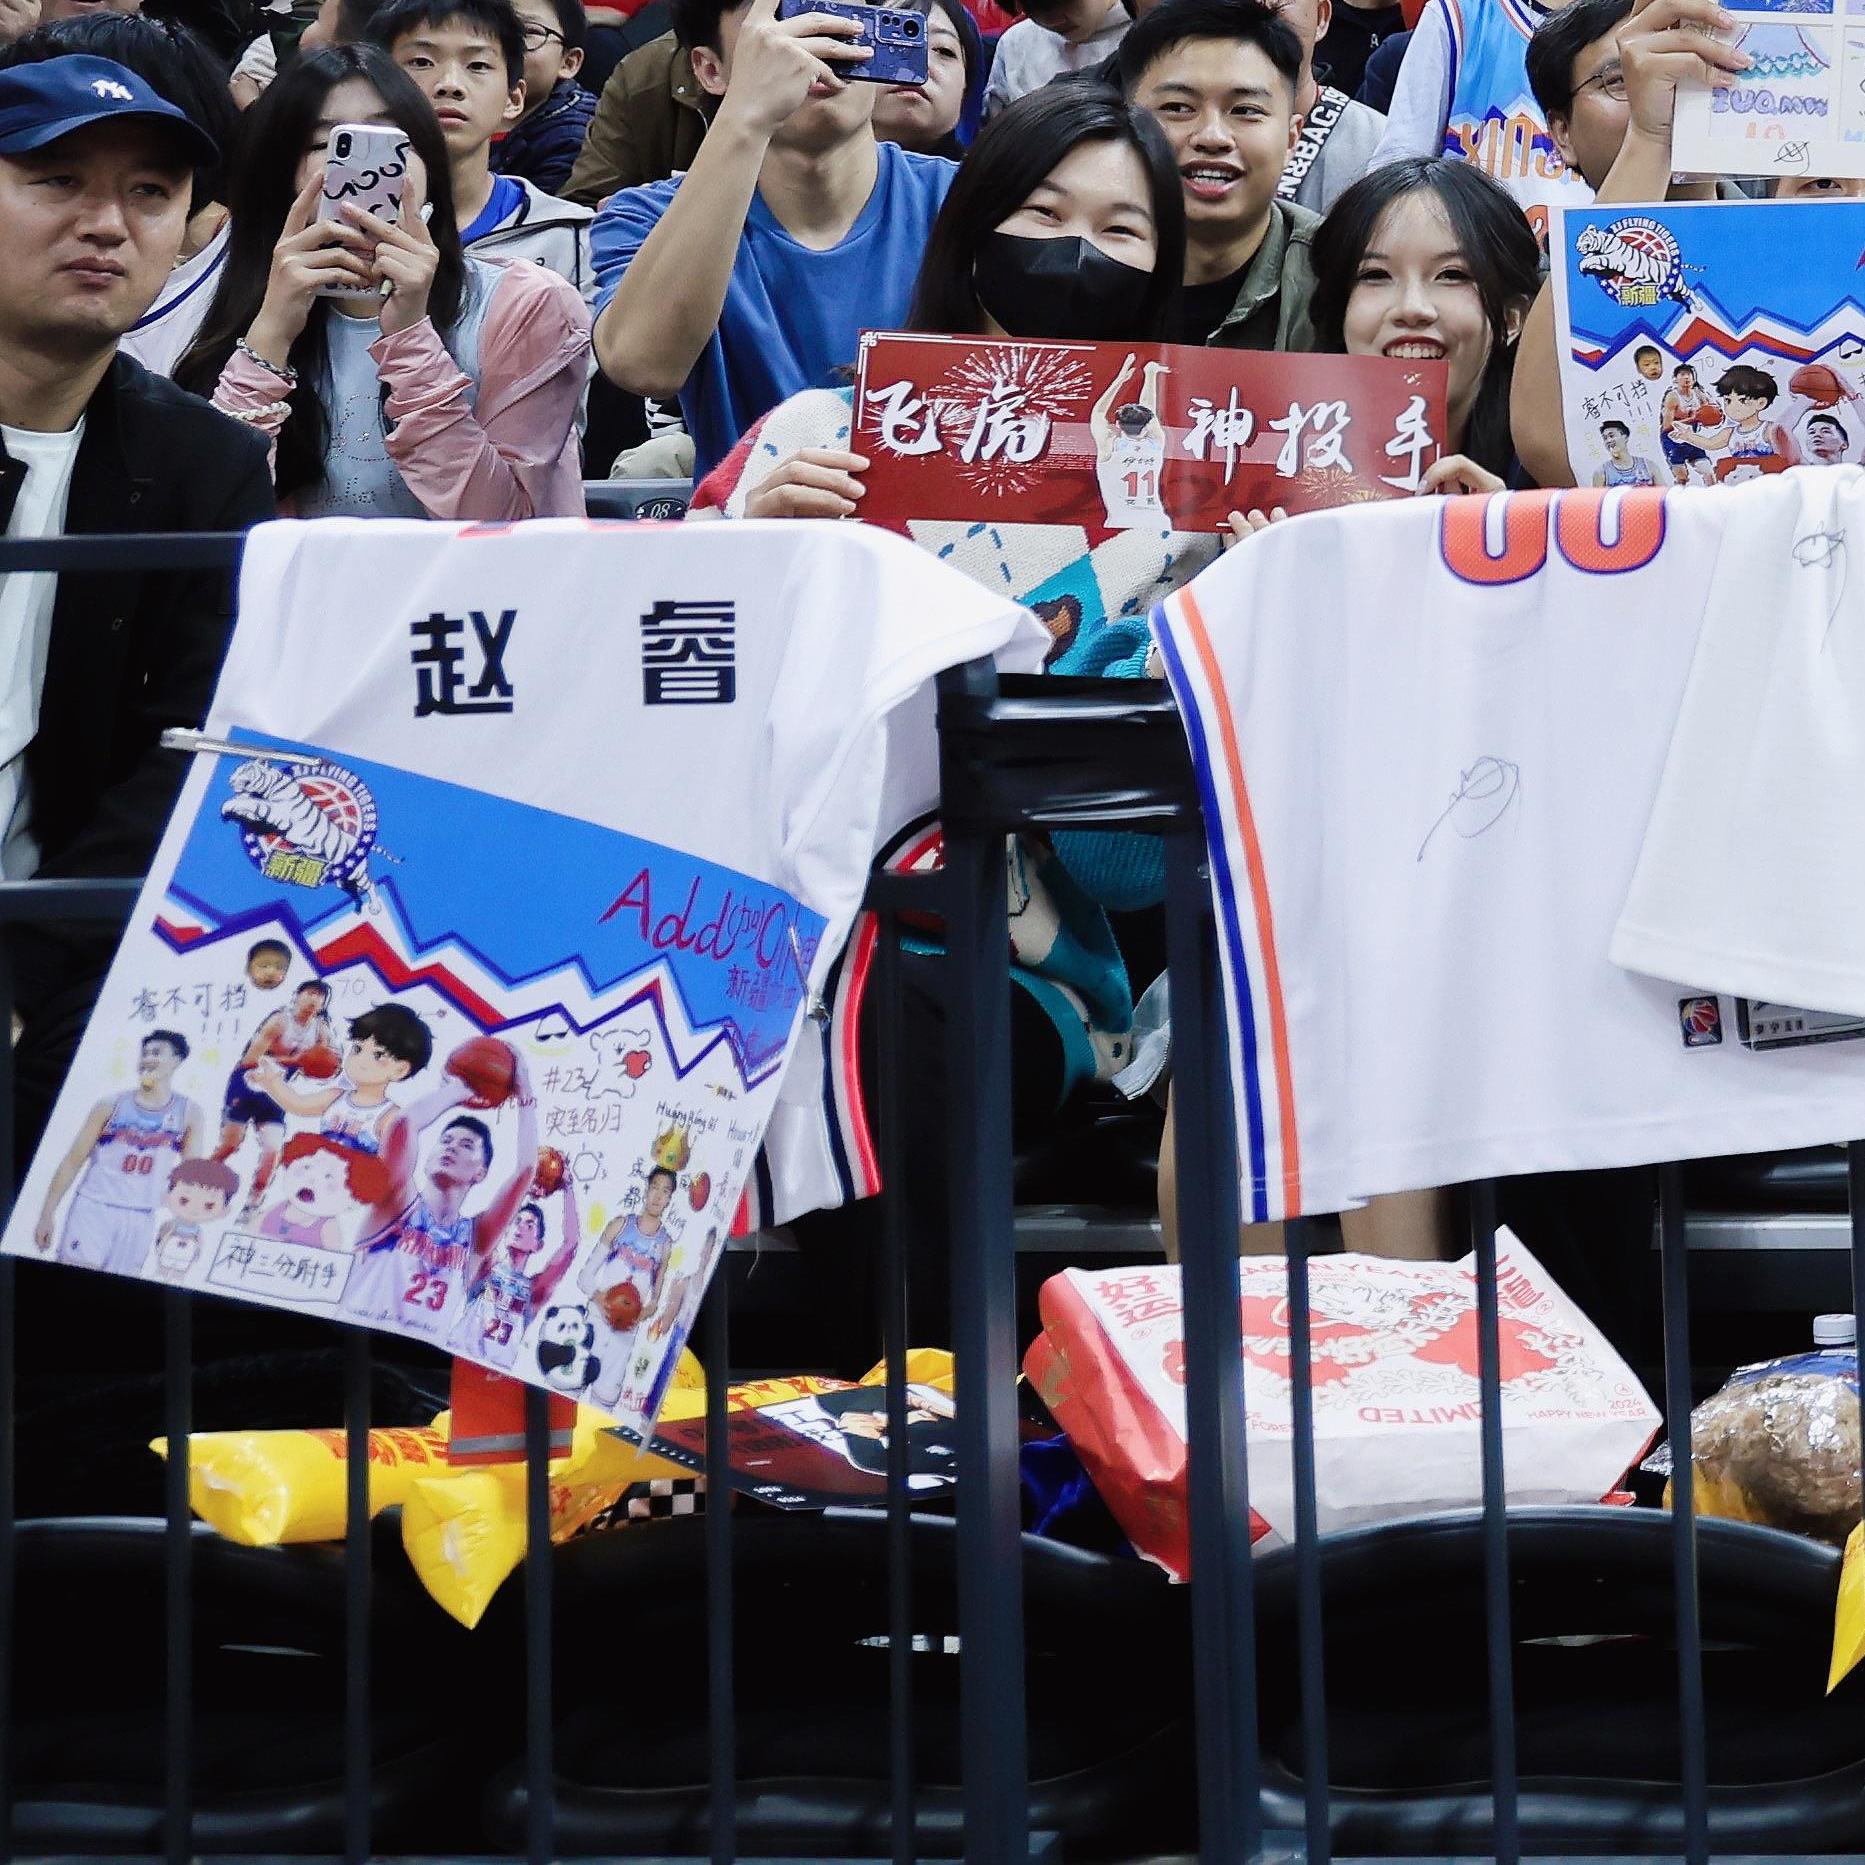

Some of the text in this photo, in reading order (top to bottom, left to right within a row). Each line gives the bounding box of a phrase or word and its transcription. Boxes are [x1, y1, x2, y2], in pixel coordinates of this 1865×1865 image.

[1620, 285, 1658, 306] 新疆
[1120, 469, 1158, 500] 11
[410, 598, 738, 719] 赵睿
[598, 867, 735, 961] Add
[402, 1269, 449, 1314] 23
[1359, 1401, 1486, 1426] IMITED
